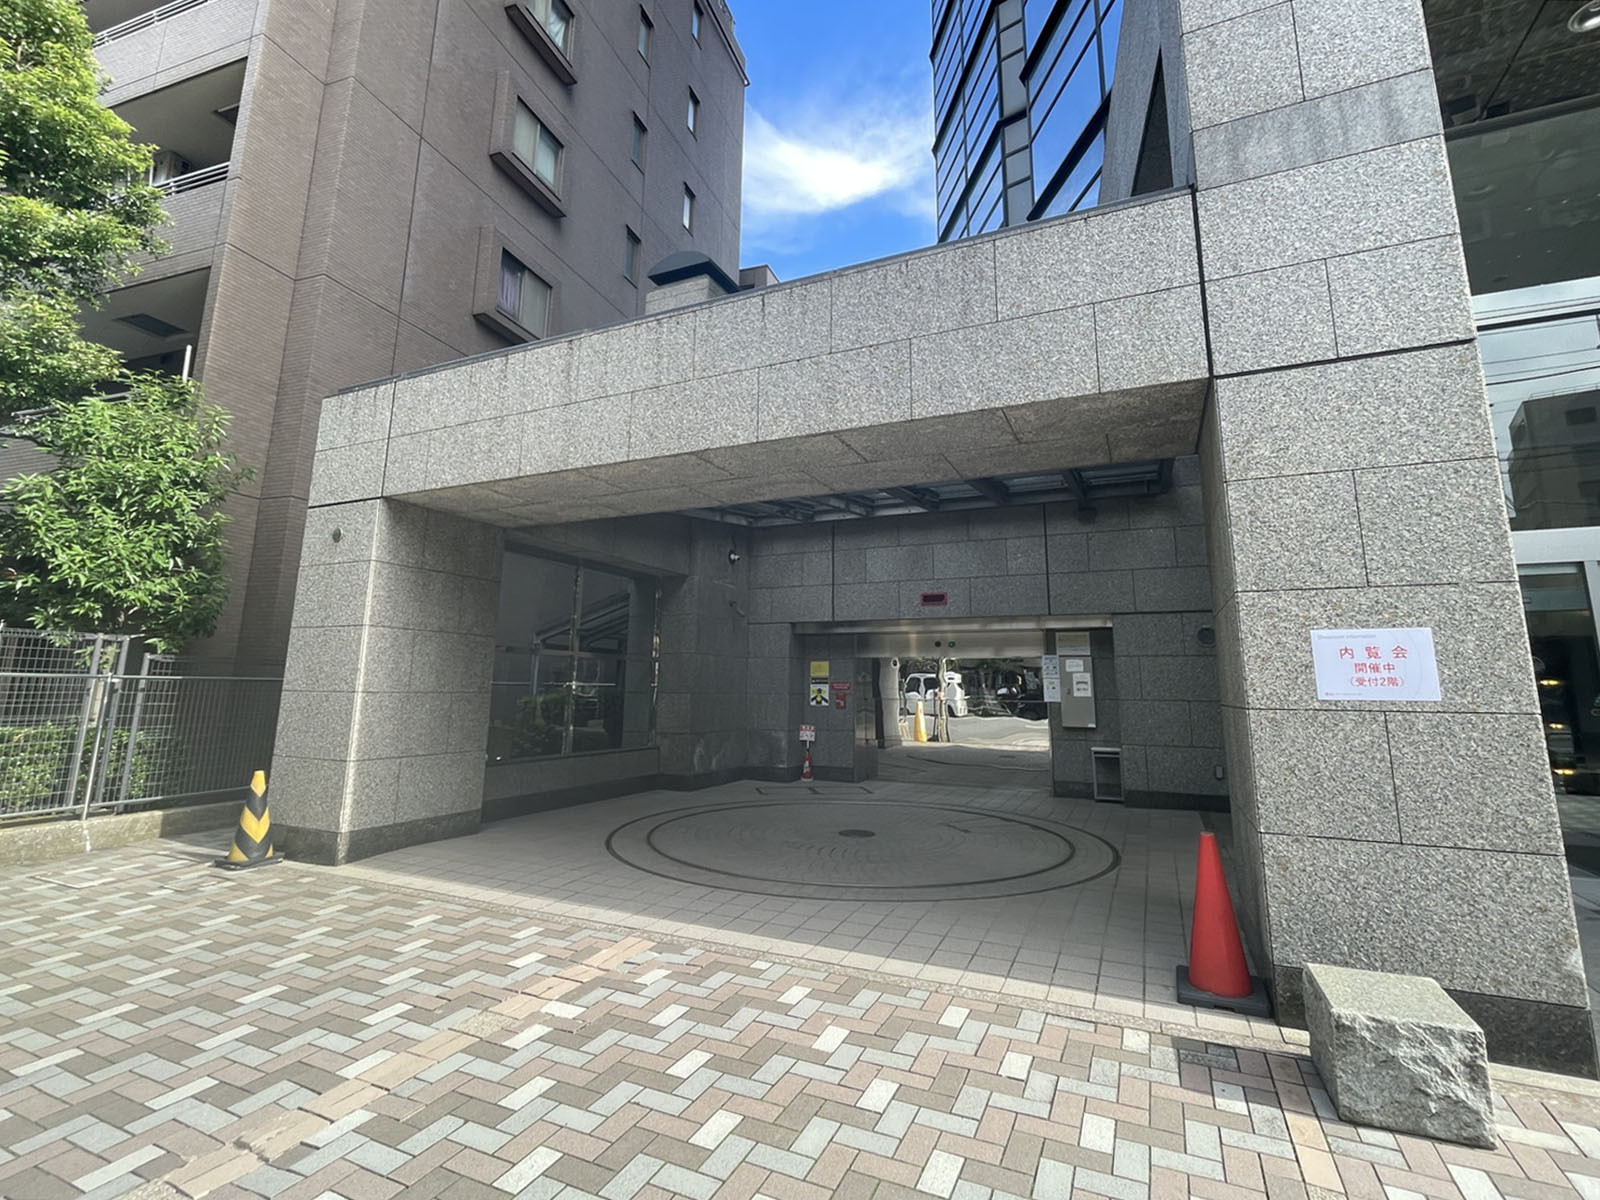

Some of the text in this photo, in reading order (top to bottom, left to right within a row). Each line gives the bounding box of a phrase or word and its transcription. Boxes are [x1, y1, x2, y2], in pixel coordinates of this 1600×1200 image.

[1339, 645, 1408, 659] 内覧会
[1354, 662, 1396, 674] 開催中
